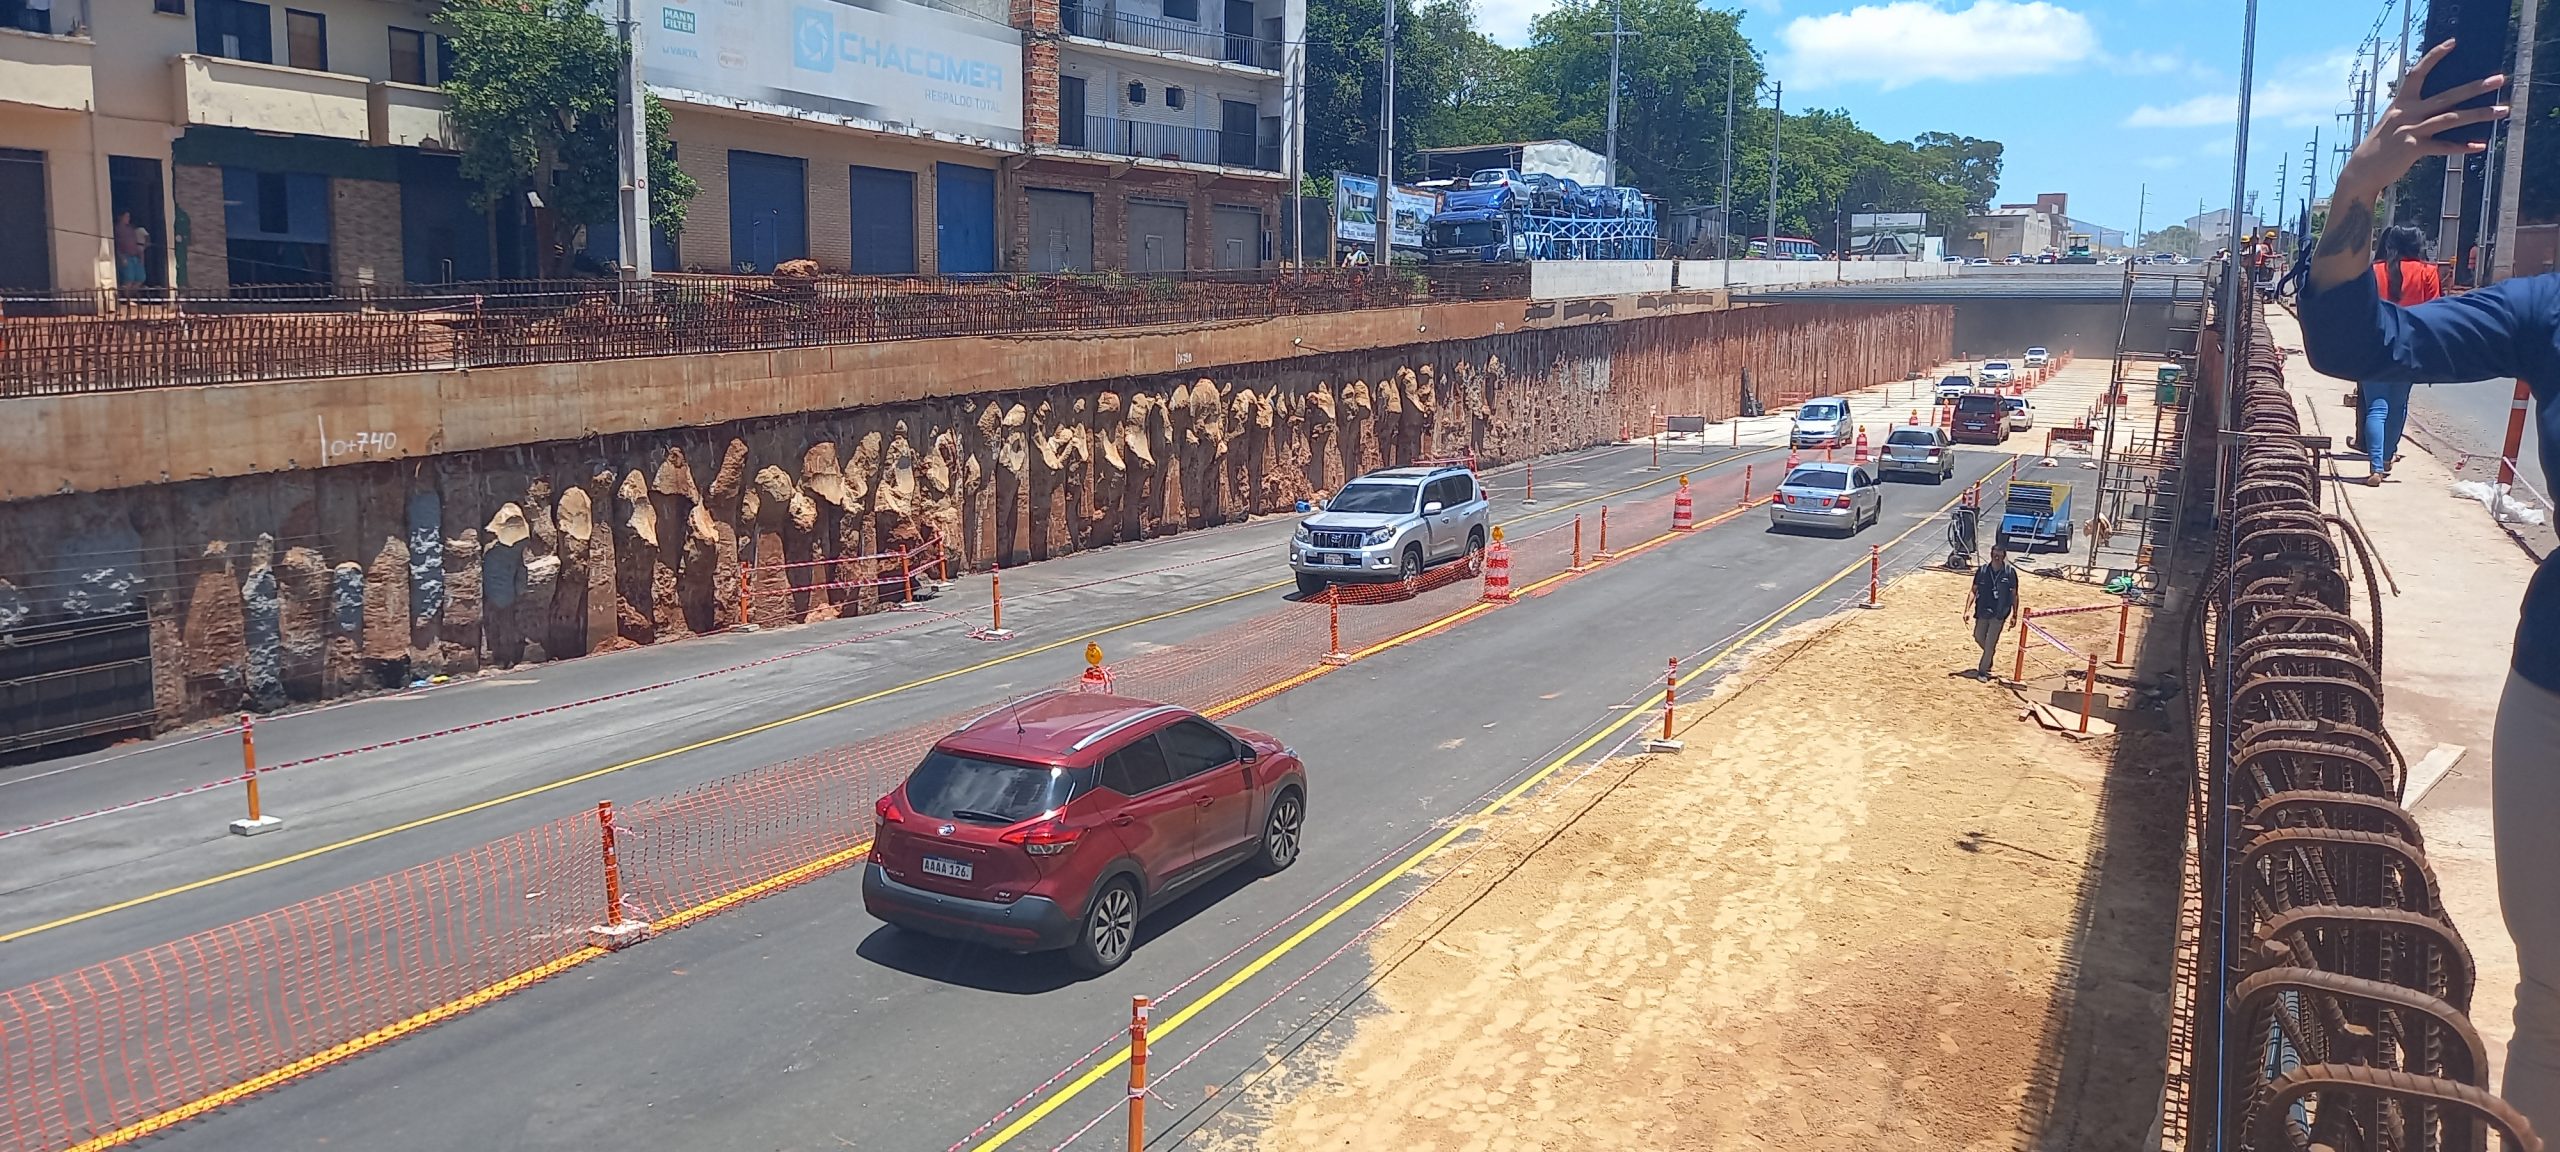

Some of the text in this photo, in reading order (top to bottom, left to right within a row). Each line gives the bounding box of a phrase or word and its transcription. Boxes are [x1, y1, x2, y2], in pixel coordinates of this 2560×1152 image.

[665, 8, 694, 22] MANN
[665, 18, 694, 32] FILTER
[839, 31, 1003, 91] CHACOMER
[925, 89, 1000, 112] RESPALDO TOTAL
[331, 431, 397, 456] 0+740
